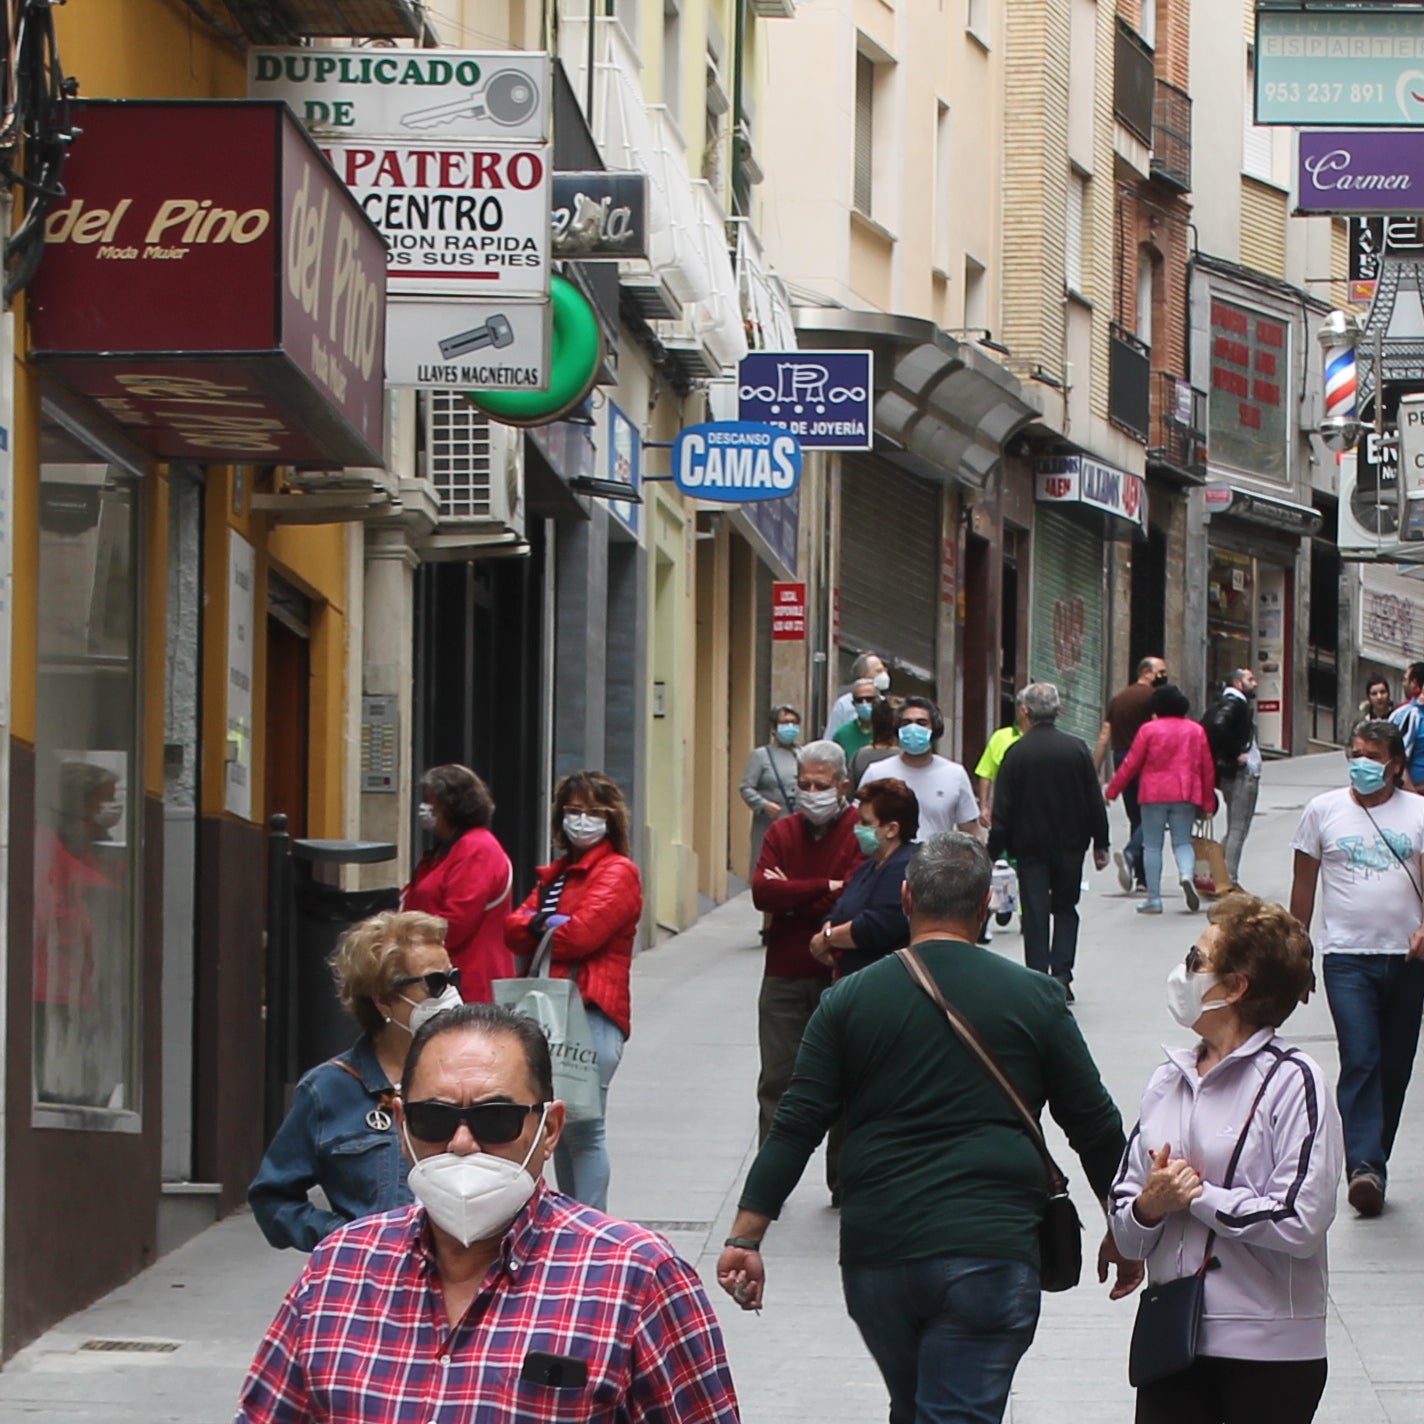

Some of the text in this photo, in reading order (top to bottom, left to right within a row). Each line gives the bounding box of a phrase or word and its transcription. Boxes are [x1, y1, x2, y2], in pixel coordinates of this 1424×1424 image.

[255, 54, 481, 86] DUPLICADO
[1264, 82, 1384, 103] 953 237 891
[304, 100, 355, 126] DE
[322, 149, 544, 191] PATERO
[1304, 150, 1412, 190] Carmen
[44, 199, 270, 244] del Pino
[362, 193, 503, 232] CENTRO
[96, 245, 139, 260] Moda
[382, 234, 538, 251] ION RAPIDA
[422, 252, 474, 266] SUS
[484, 253, 541, 267] PIES
[417, 362, 538, 385] LLAVES MAGNÉTICAS
[708, 432, 771, 446] DESCANSO
[790, 421, 808, 435] DE
[809, 419, 866, 436] JOYERÍA
[680, 433, 795, 490] CAMAS
